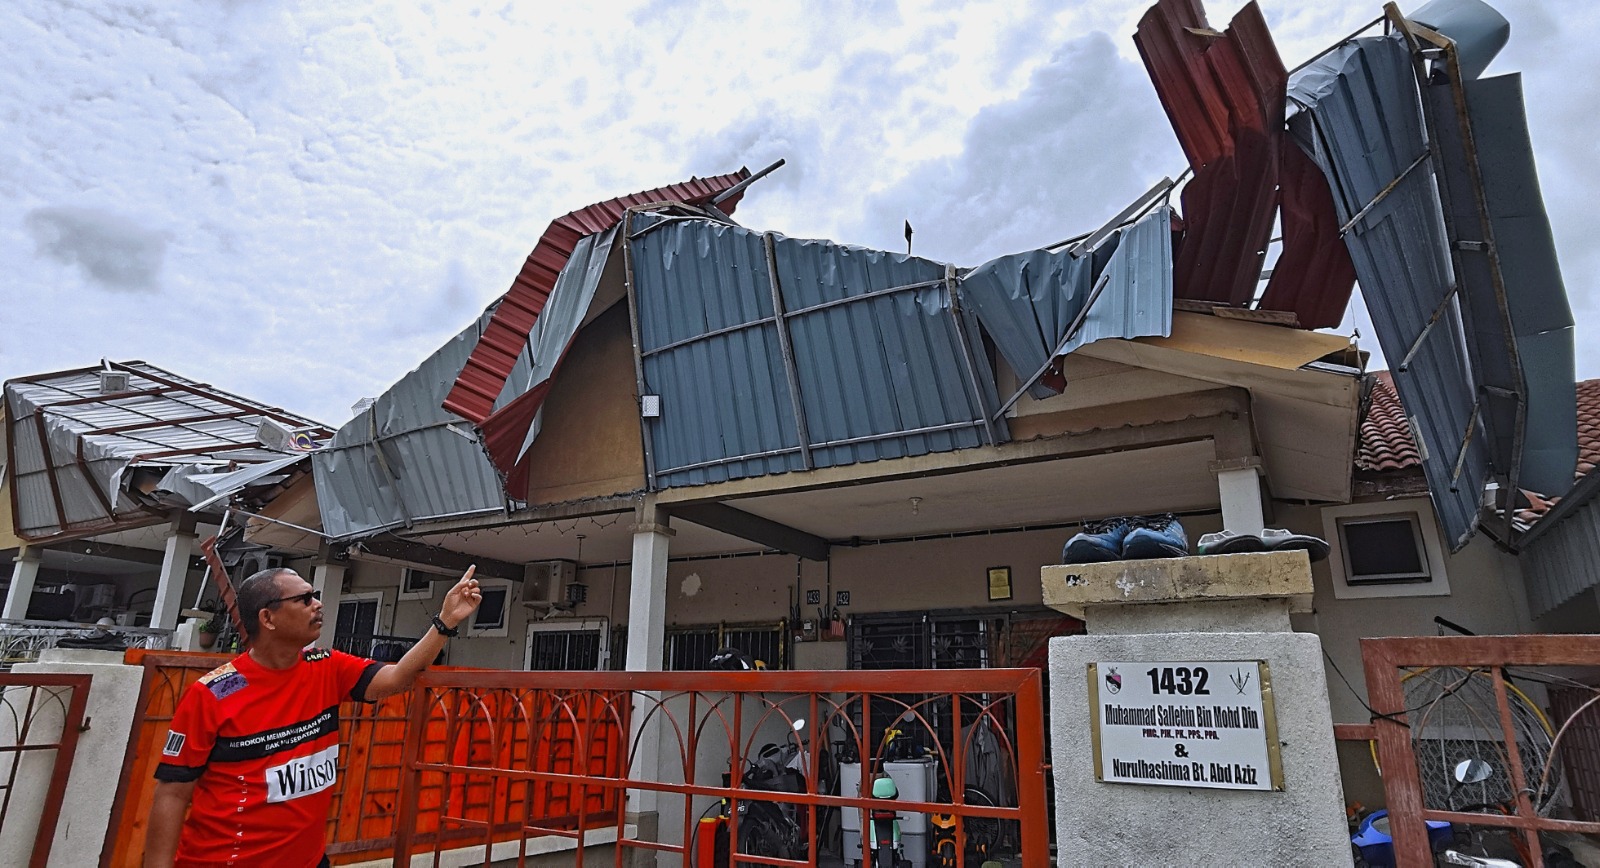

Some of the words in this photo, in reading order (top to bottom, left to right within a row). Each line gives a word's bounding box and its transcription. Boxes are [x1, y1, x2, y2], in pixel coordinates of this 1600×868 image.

[1147, 667, 1210, 695] 1432
[1105, 704, 1157, 726] Muhammad
[1157, 705, 1196, 727] Sallehin
[1196, 705, 1213, 728] Bin
[1213, 705, 1241, 728] Mohd
[1241, 706, 1259, 729] Din
[1174, 743, 1189, 758] &
[1112, 758, 1190, 781] Nurulhashima
[1191, 762, 1208, 782] Bt.
[1209, 762, 1233, 783] Abd
[1234, 763, 1258, 785] Aziz
